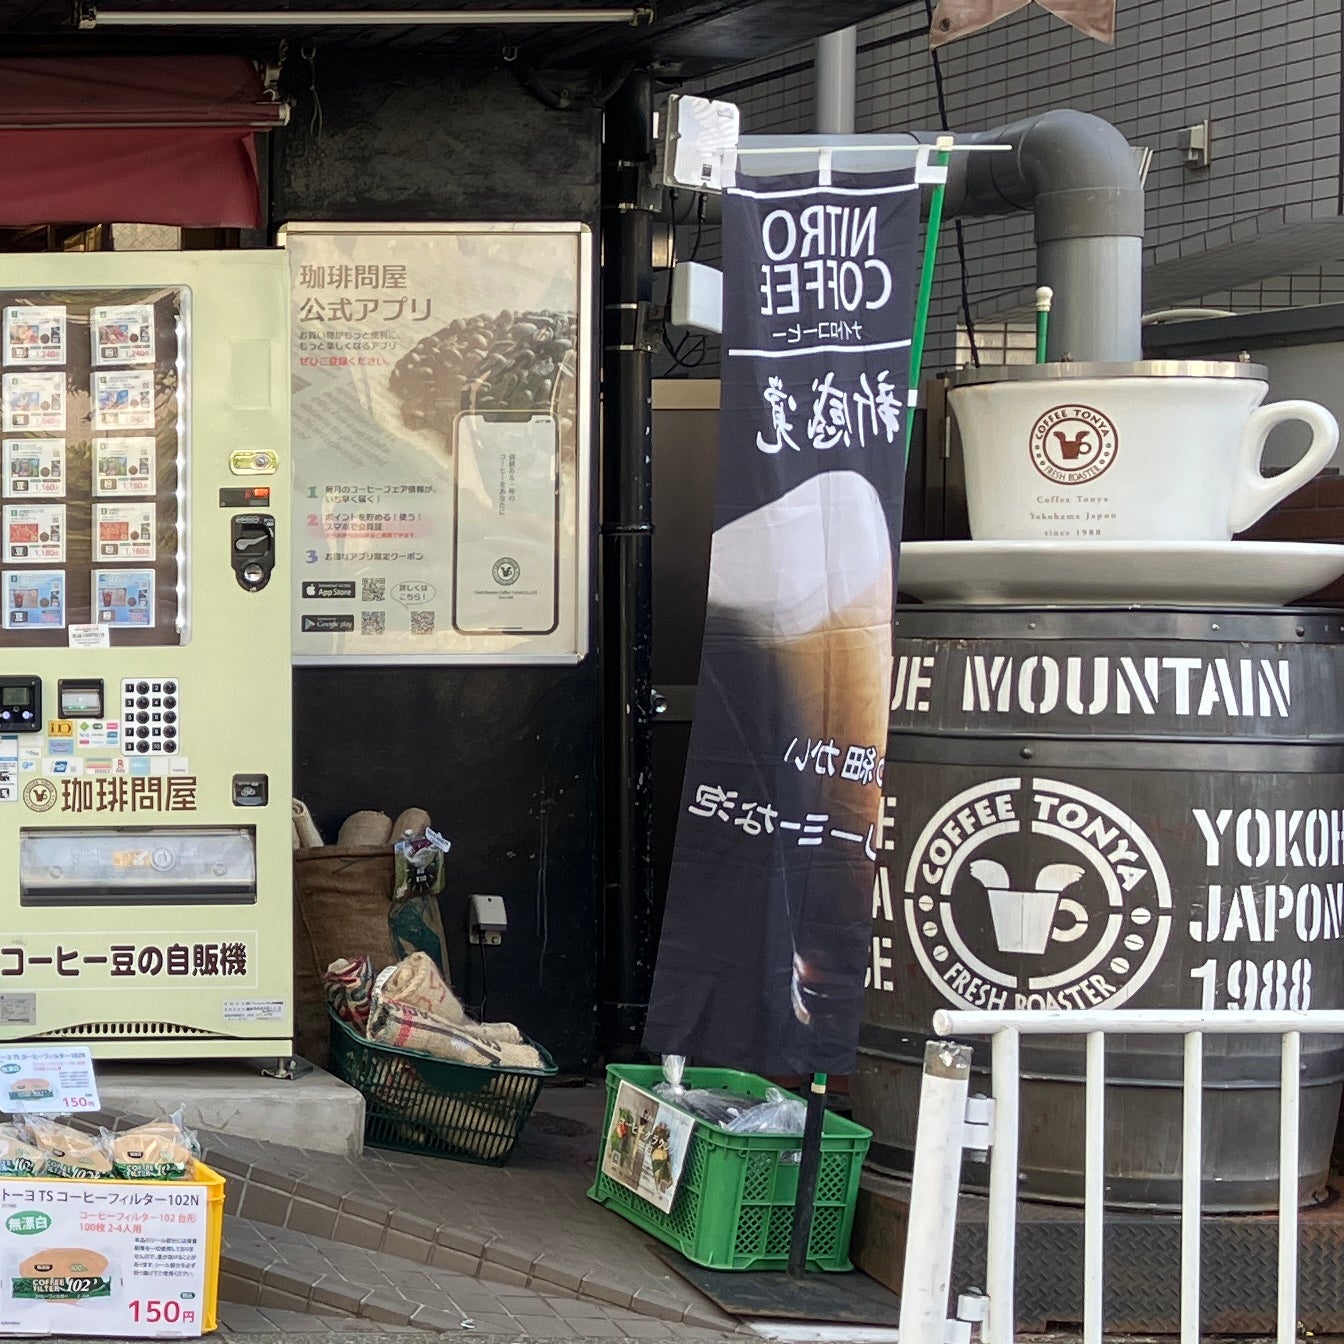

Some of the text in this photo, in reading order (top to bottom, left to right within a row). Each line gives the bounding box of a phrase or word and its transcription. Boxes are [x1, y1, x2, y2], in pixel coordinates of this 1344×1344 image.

[299, 264, 408, 289] 珈琲問屋
[299, 296, 432, 322] 公式アプリ
[300, 341, 397, 350] もっと楽しくなるアプリ
[1036, 409, 1110, 440] COFFEE TONYA
[1068, 465, 1102, 481] ROASTER
[306, 486, 318, 498] 1
[1036, 495, 1109, 504] Coffee Tonya
[306, 514, 319, 526] 2
[1030, 512, 1081, 520] Yokohama
[1076, 529, 1102, 537] 1988
[306, 550, 318, 563] 3
[318, 587, 352, 597] App Store
[316, 619, 338, 629] Google
[962, 655, 1291, 718] MOUNTAIN
[61, 777, 197, 812] 珈琲問屋
[923, 794, 1148, 892] COFFEE TONYA
[0, 943, 247, 977] コーヒー豆の自販機
[944, 962, 1117, 1011] FRESH ROASTER
[1189, 958, 1312, 1011] 1988
[62, 1097, 95, 1108] 150円
[2, 1188, 199, 1206] トーヨ TS コーヒーフィルター102N
[8, 1216, 49, 1231] 無漂白
[80, 1211, 197, 1223] コーヒーフィルター102 台形
[79, 1223, 142, 1234] 100枚 2-4人用
[33, 1278, 65, 1286] COFFEE
[33, 1284, 62, 1293] FILTER
[68, 1279, 91, 1292] 102
[128, 1300, 195, 1323] 150円
